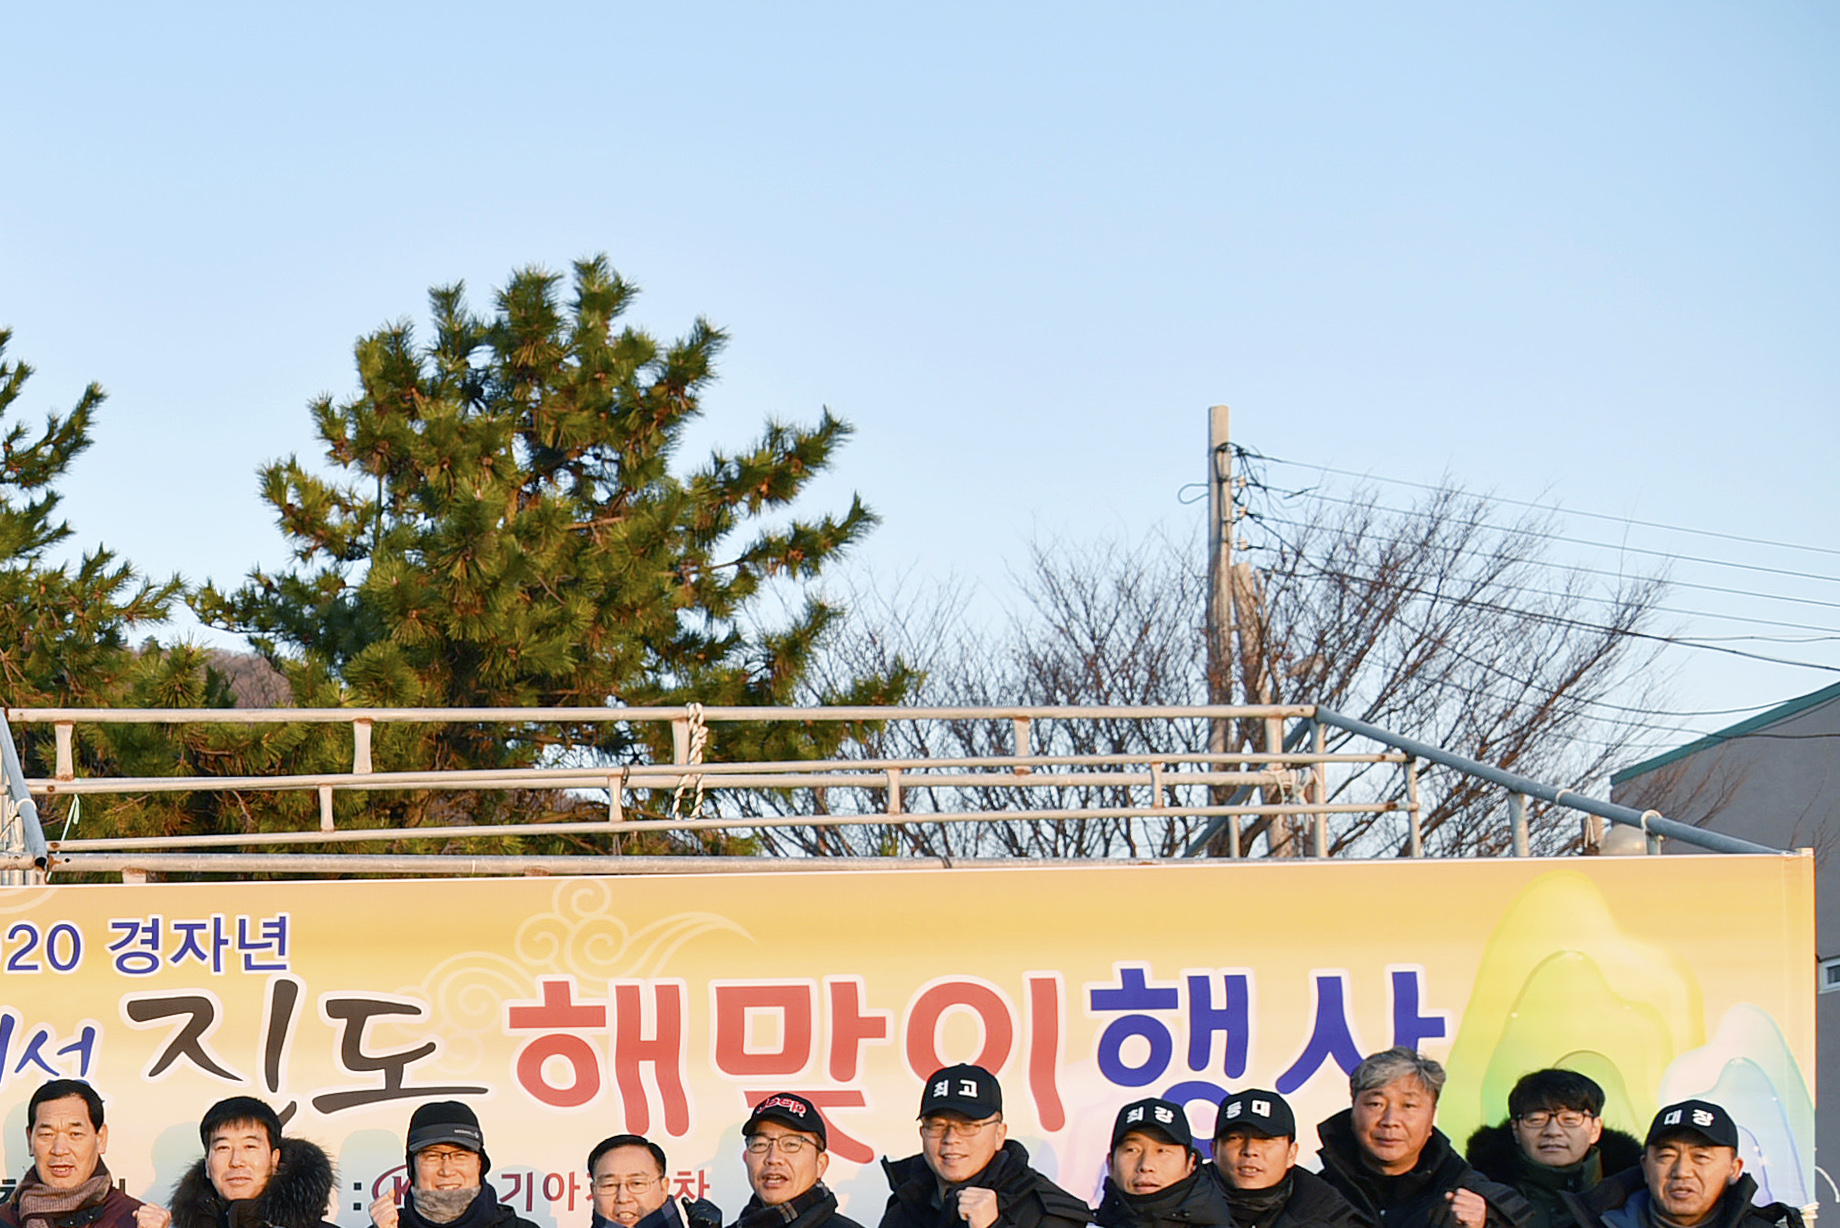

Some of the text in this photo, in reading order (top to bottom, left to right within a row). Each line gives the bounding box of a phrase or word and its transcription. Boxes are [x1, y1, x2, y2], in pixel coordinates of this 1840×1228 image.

[108, 914, 288, 974] 경자년
[126, 978, 489, 1128] 진도
[499, 1168, 711, 1212] 기아차
